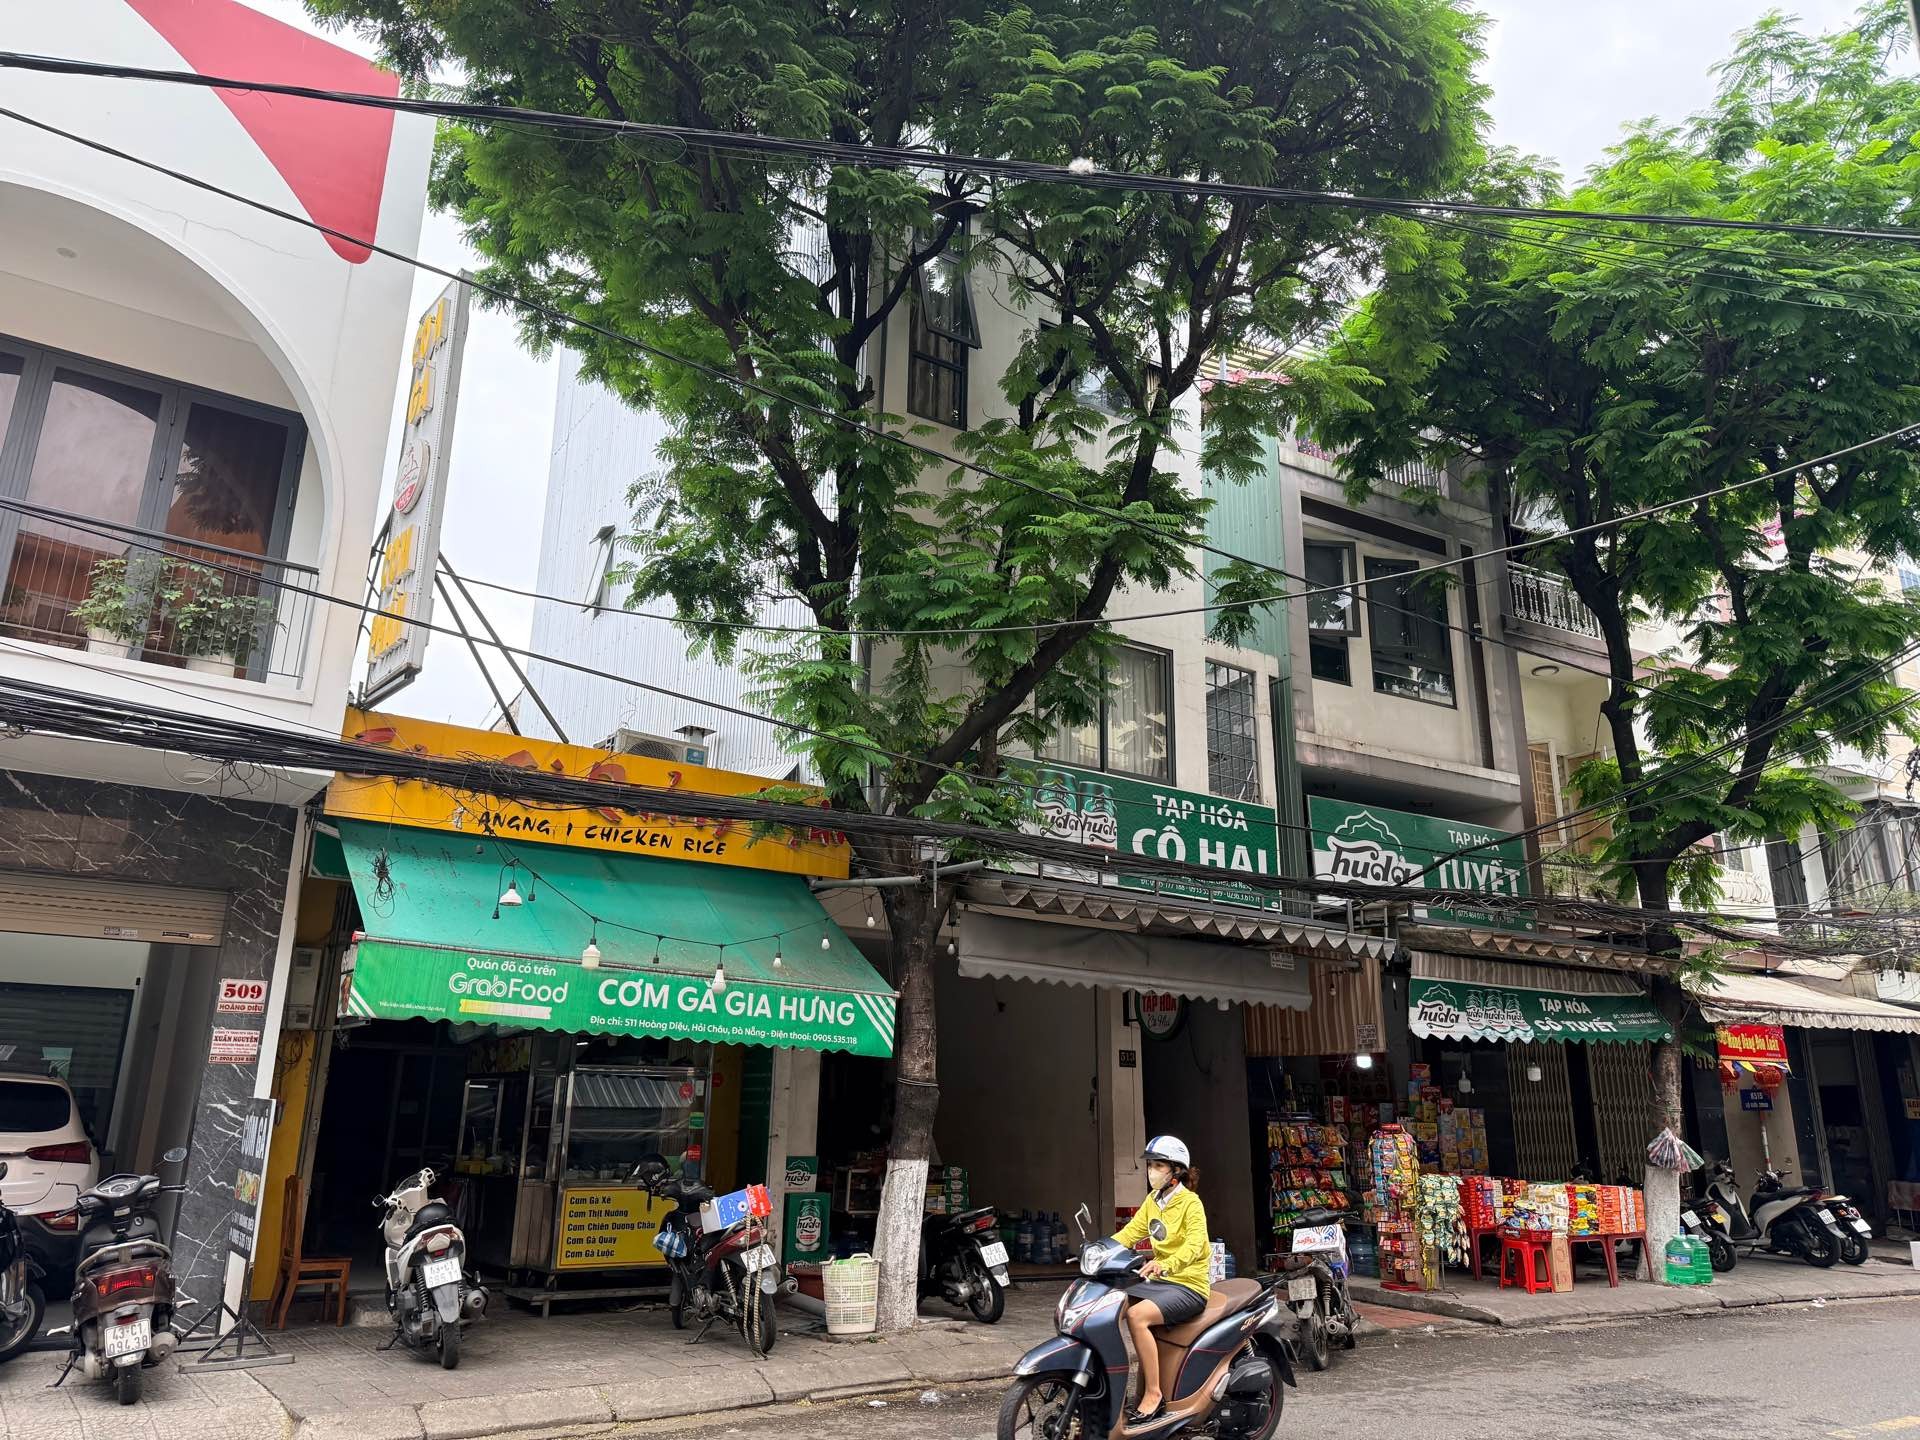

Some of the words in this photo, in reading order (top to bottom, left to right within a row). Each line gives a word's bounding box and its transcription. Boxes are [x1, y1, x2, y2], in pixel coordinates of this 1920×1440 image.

[1152, 794, 1195, 823] TẠP
[1200, 804, 1248, 831] HÓA
[584, 825, 673, 849] CHICKEN
[684, 838, 727, 855] RICE
[1448, 829, 1472, 849] TẠP
[1132, 825, 1186, 862] CÔ
[1199, 837, 1268, 874] HAI
[1331, 842, 1411, 884] huda
[1433, 855, 1520, 897] TUYẾT
[467, 957, 499, 971] Quán
[500, 959, 516, 972] đã
[519, 961, 531, 974] có
[534, 963, 556, 977] trên
[224, 983, 262, 999] 509
[449, 972, 568, 1003] GrabFood
[219, 1002, 246, 1010] HOÀNG
[247, 1004, 262, 1012] DIỆU
[598, 978, 670, 1009] CƠM
[677, 980, 718, 1014] GÀ
[725, 991, 772, 1018] GIA
[779, 995, 855, 1026] HƯNG
[1539, 998, 1561, 1015] TẠP
[1563, 998, 1592, 1014] HÓA
[1418, 1002, 1459, 1023] huda
[590, 1016, 606, 1026] Địa
[607, 1016, 623, 1026] chỉ:
[625, 1018, 637, 1027] 511
[639, 1019, 667, 1031] Hoàng
[669, 1021, 690, 1032] Diệu,
[691, 1023, 706, 1033] Hải
[707, 1024, 730, 1035] Châu,
[732, 1026, 743, 1035] Đà
[745, 1026, 765, 1039] Nẵng
[771, 1028, 788, 1040] Điện
[813, 1034, 857, 1045] 0905.535.118
[1534, 1017, 1563, 1031] CÔ
[1561, 1017, 1618, 1032] TUYẾT
[785, 1170, 811, 1183] huda
[570, 1196, 587, 1205] Cơm
[589, 1196, 599, 1205] Gà
[569, 1210, 586, 1218] Cơm
[589, 1209, 602, 1219] Thịt
[797, 1217, 820, 1230] huda
[567, 1223, 585, 1232] Cơm
[587, 1222, 609, 1231] Chiên
[637, 1221, 656, 1230] Châu
[566, 1237, 583, 1245] Cơm
[586, 1236, 596, 1244] Gà
[599, 1235, 617, 1246] Quay
[565, 1250, 582, 1258] Cơm
[585, 1249, 595, 1258] Gà
[597, 1249, 615, 1259] Luộc
[109, 1335, 148, 1355] 094.38
